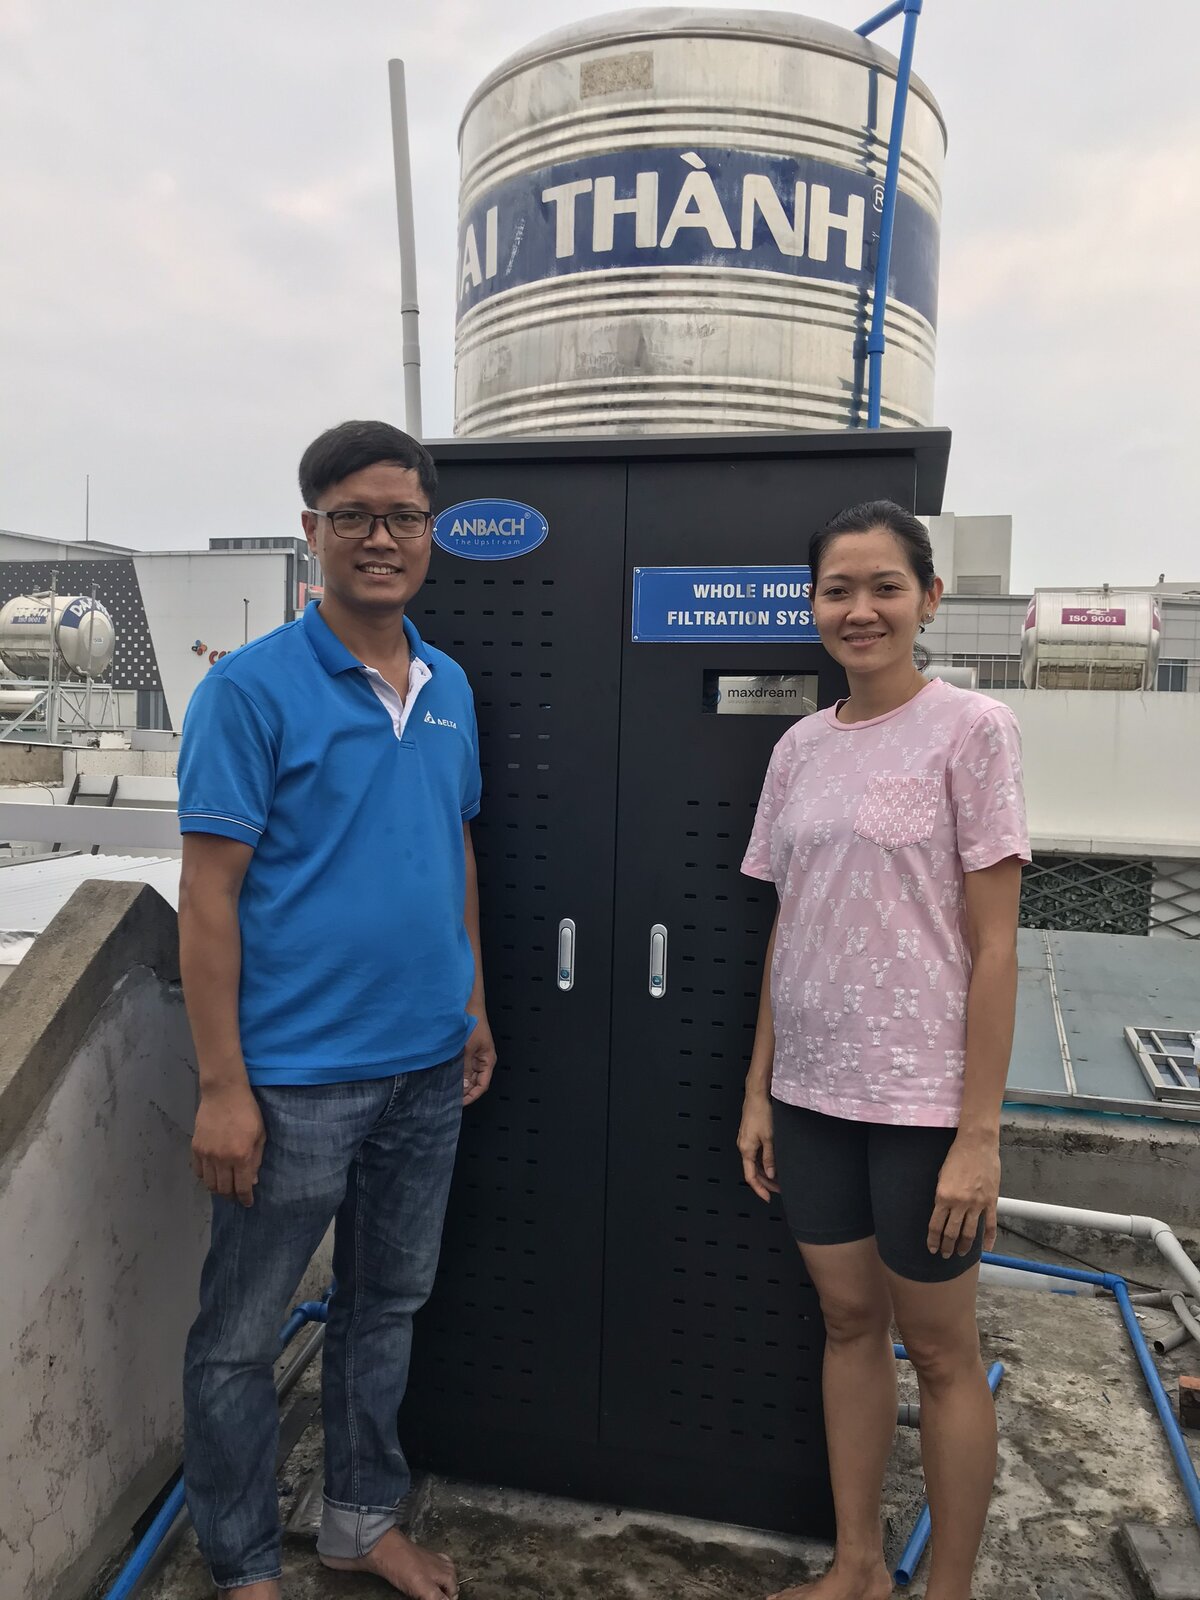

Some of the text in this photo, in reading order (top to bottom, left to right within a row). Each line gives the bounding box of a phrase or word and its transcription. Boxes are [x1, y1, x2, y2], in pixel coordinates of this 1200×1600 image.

[458, 205, 498, 300] ẠI
[542, 152, 866, 271] THÀNH
[449, 518, 525, 537] ANBACH
[474, 539, 521, 547] Upstream
[693, 583, 813, 599] WHOLE HOUS
[667, 610, 817, 626] FILTRATION SYS
[1069, 614, 1117, 623] ISO 9001
[728, 687, 797, 698] maxdream
[437, 718, 457, 729] DELTA
